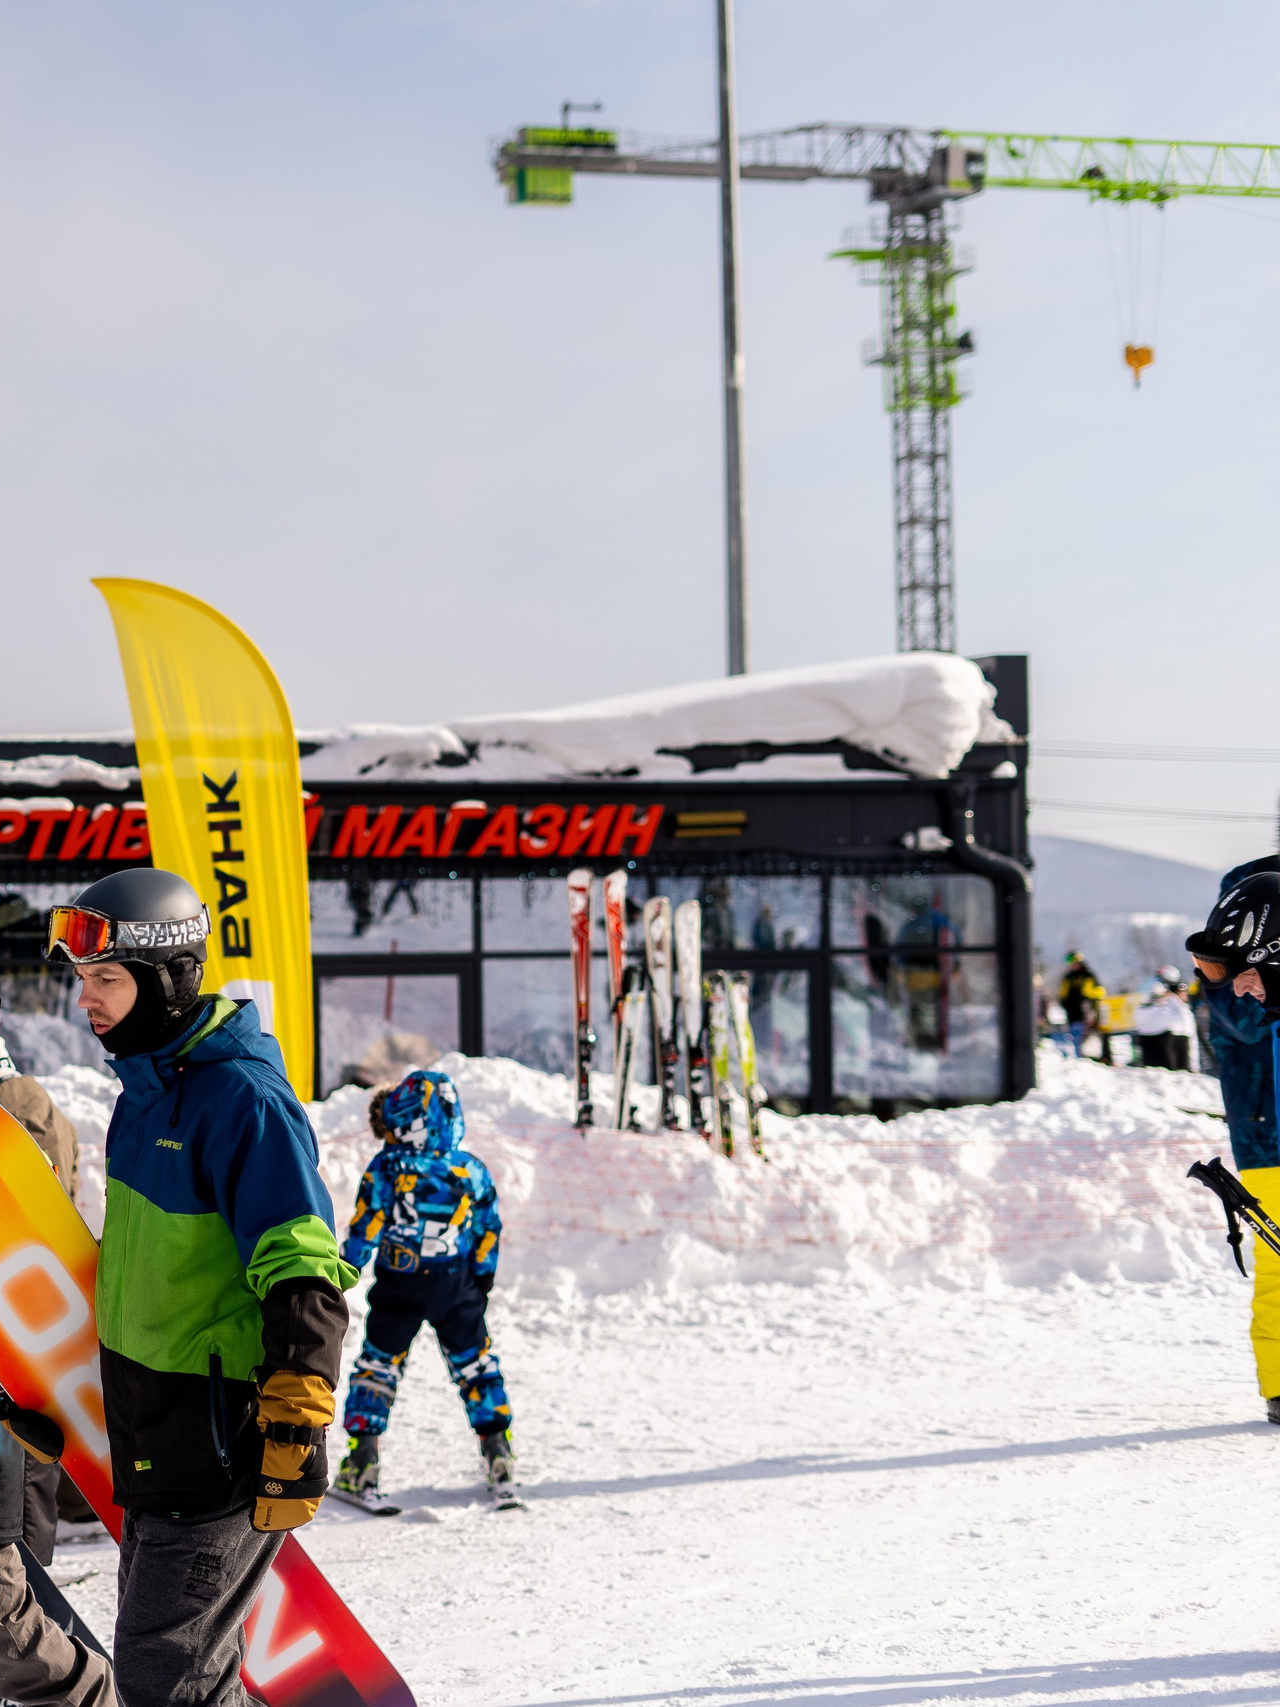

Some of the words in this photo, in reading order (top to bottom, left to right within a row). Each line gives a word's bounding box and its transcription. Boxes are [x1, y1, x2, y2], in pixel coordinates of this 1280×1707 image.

[332, 803, 665, 858] МАГАЗИН
[133, 919, 202, 938] SMITH
[136, 930, 204, 948] OPTICS
